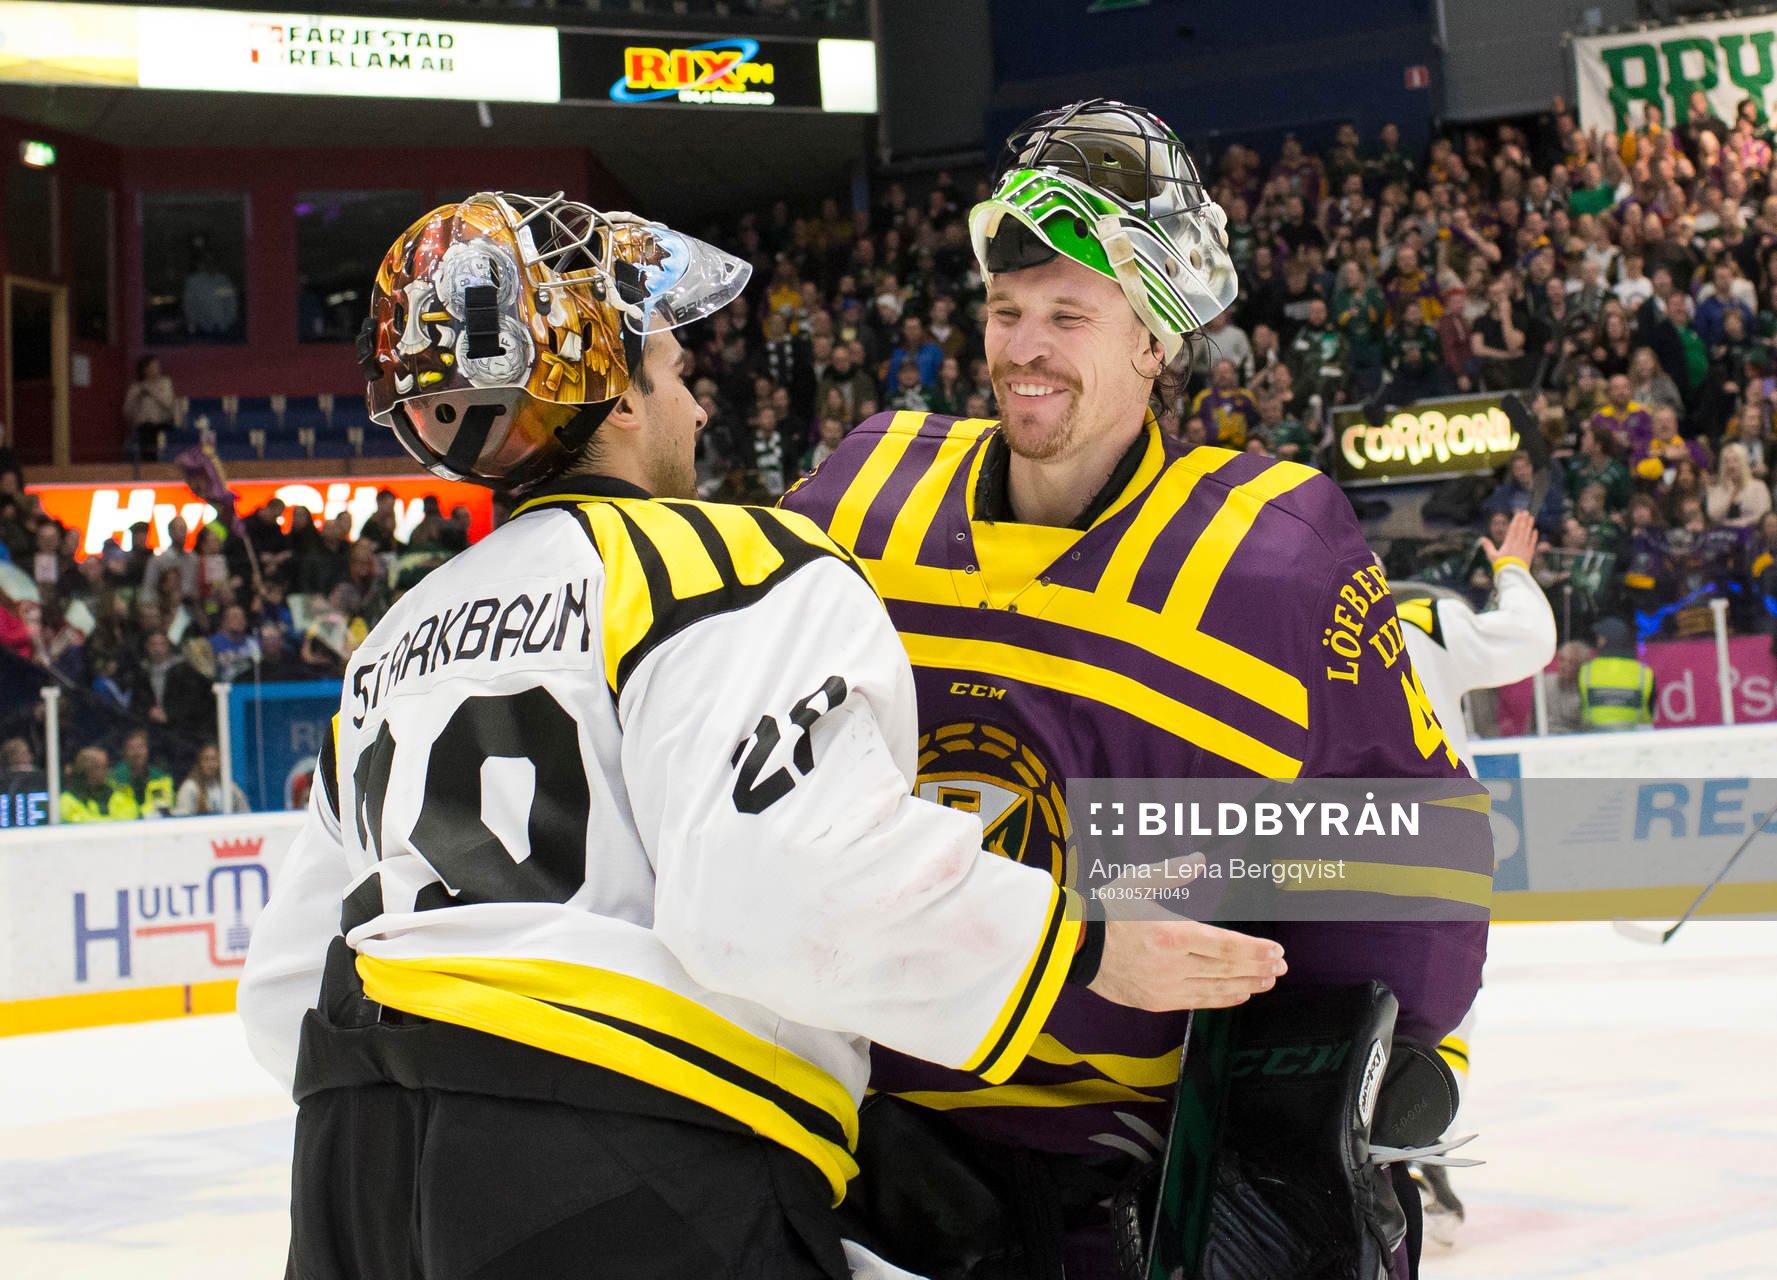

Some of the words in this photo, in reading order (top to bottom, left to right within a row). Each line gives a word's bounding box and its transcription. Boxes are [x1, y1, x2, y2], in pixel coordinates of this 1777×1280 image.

[289, 49, 411, 70] REKLAM
[624, 47, 746, 92] RIX
[352, 578, 590, 730] STARKBAUM
[950, 682, 1008, 701] CCM
